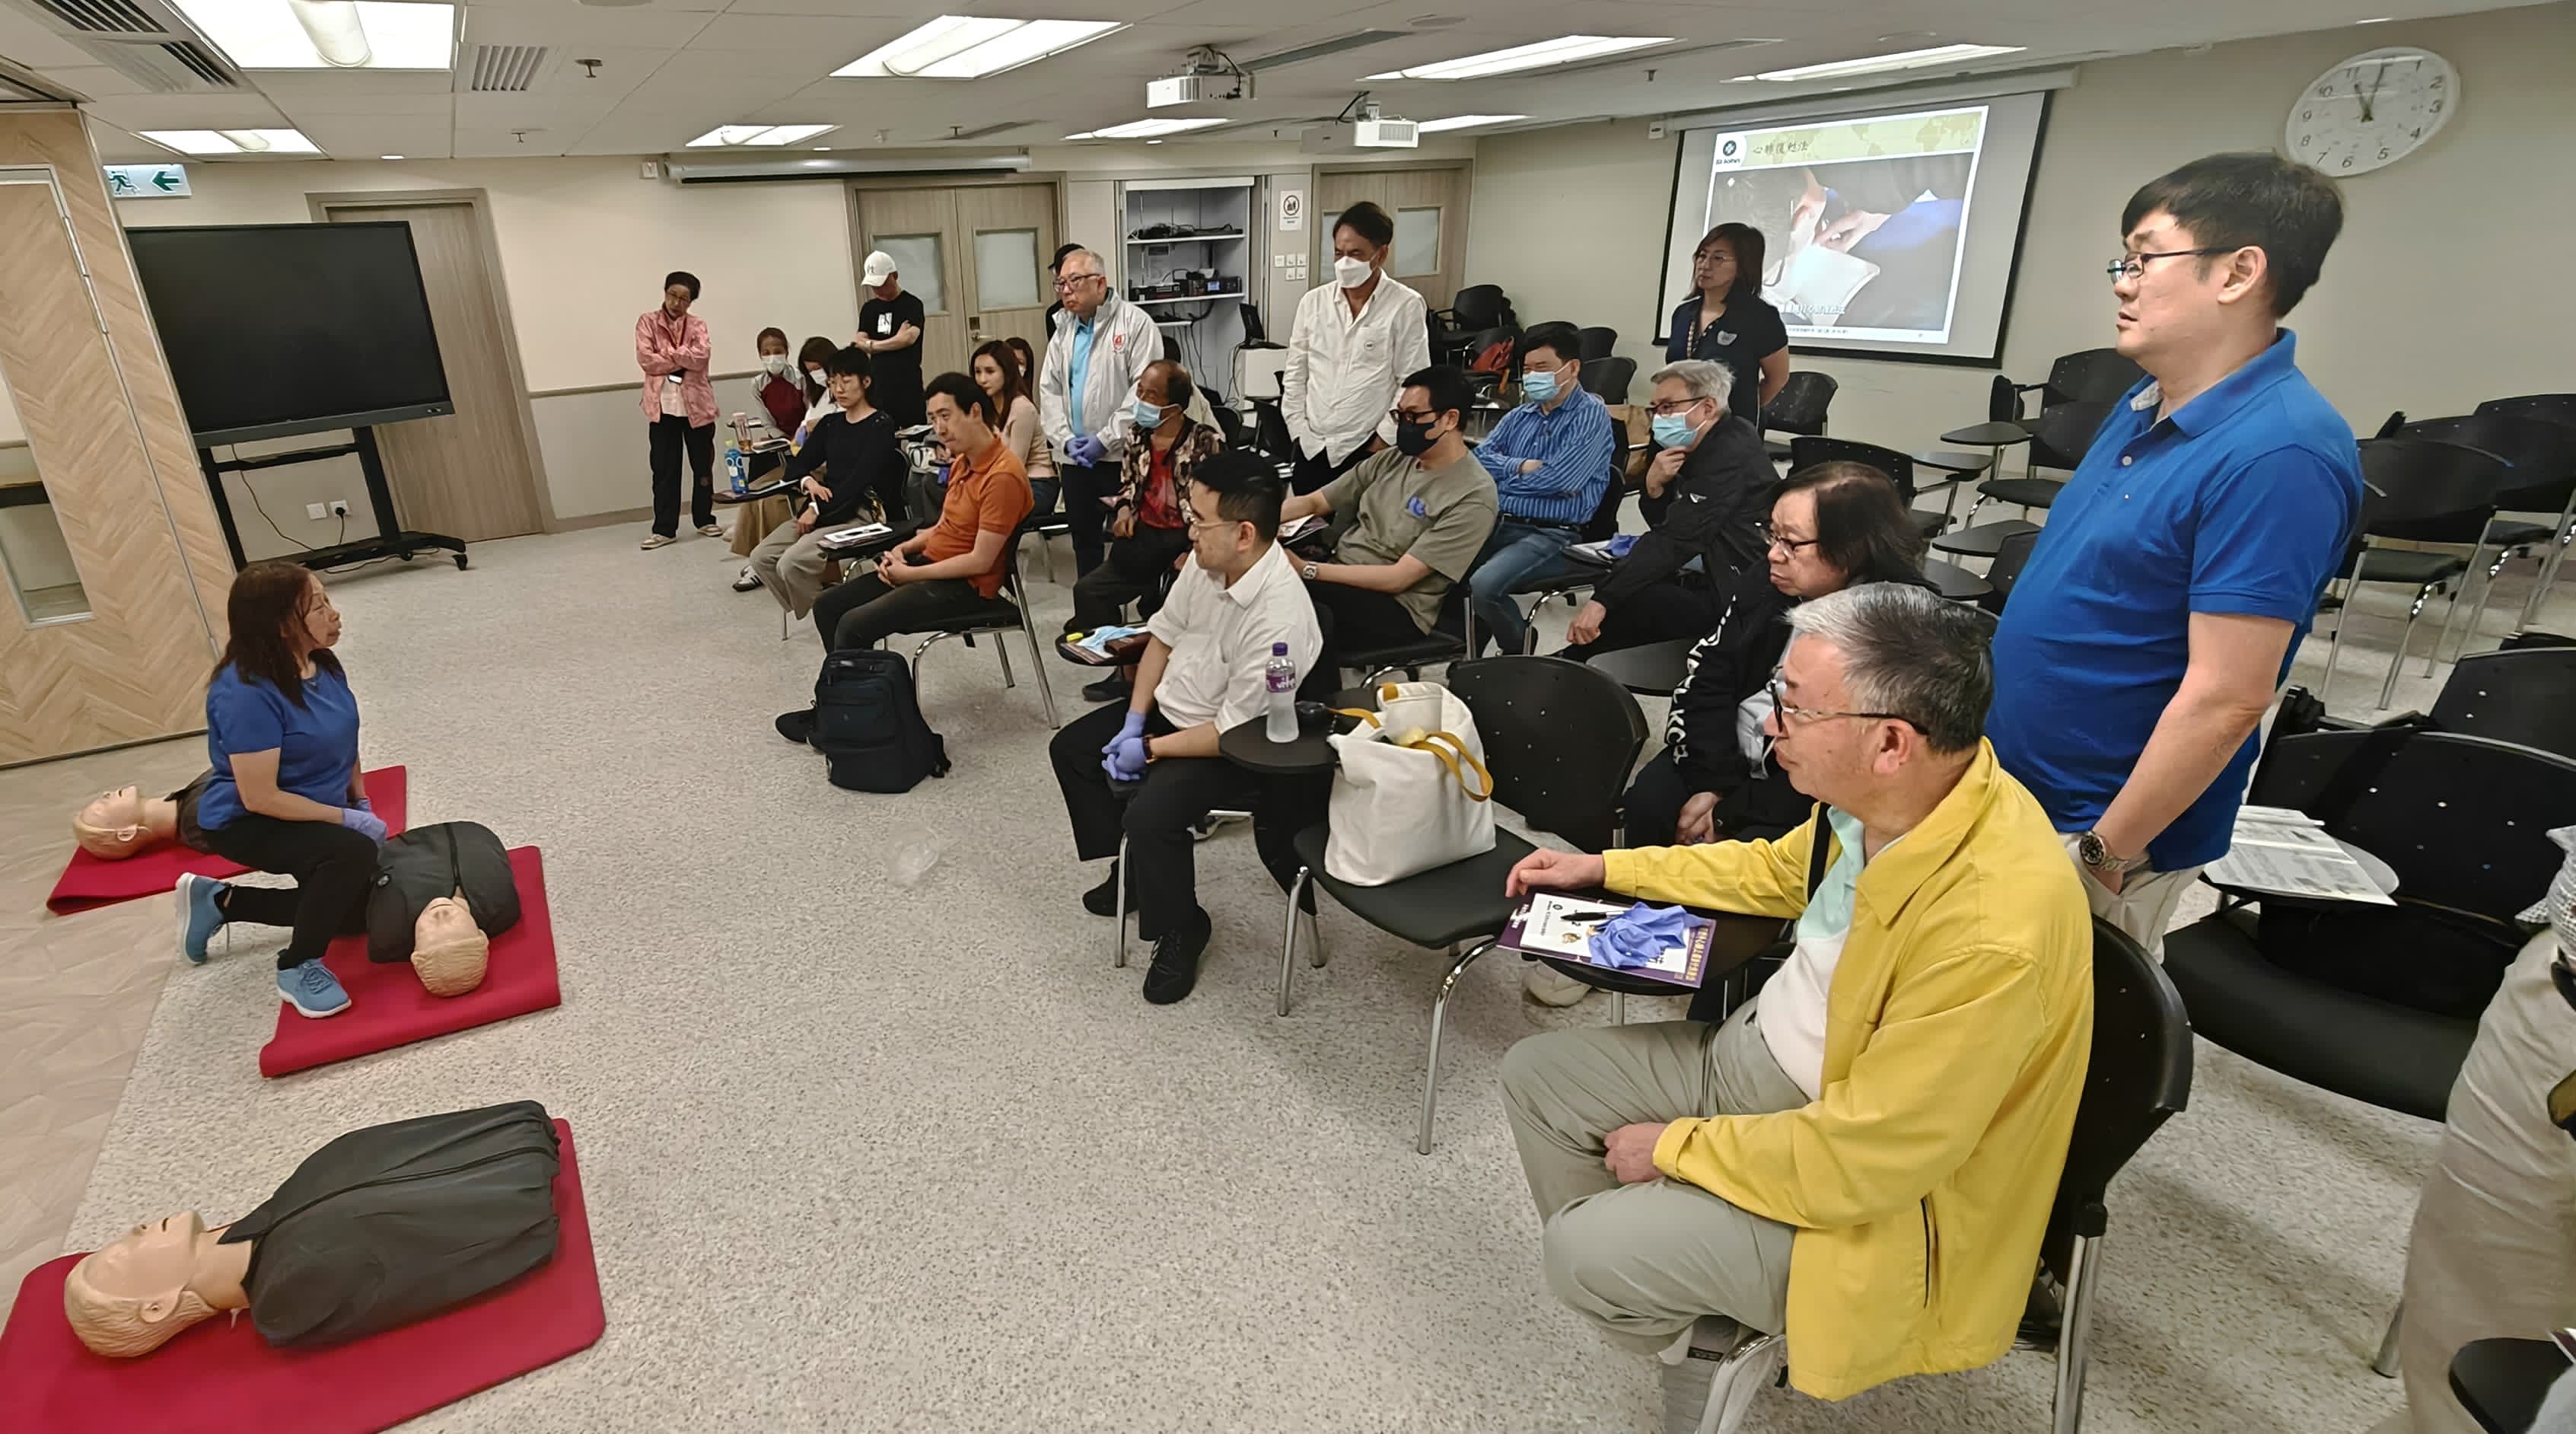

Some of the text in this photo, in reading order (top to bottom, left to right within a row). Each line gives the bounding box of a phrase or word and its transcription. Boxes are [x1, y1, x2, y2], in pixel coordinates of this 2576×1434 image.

[2428, 73, 2444, 90] 2
[2318, 84, 2334, 98] 10
[2428, 100, 2443, 114] 3
[2302, 110, 2313, 123] 9
[2410, 126, 2422, 140] 4
[2301, 134, 2311, 147] 8
[2316, 151, 2328, 164] 7
[2377, 147, 2390, 161] 5
[2342, 156, 2355, 168] 6
